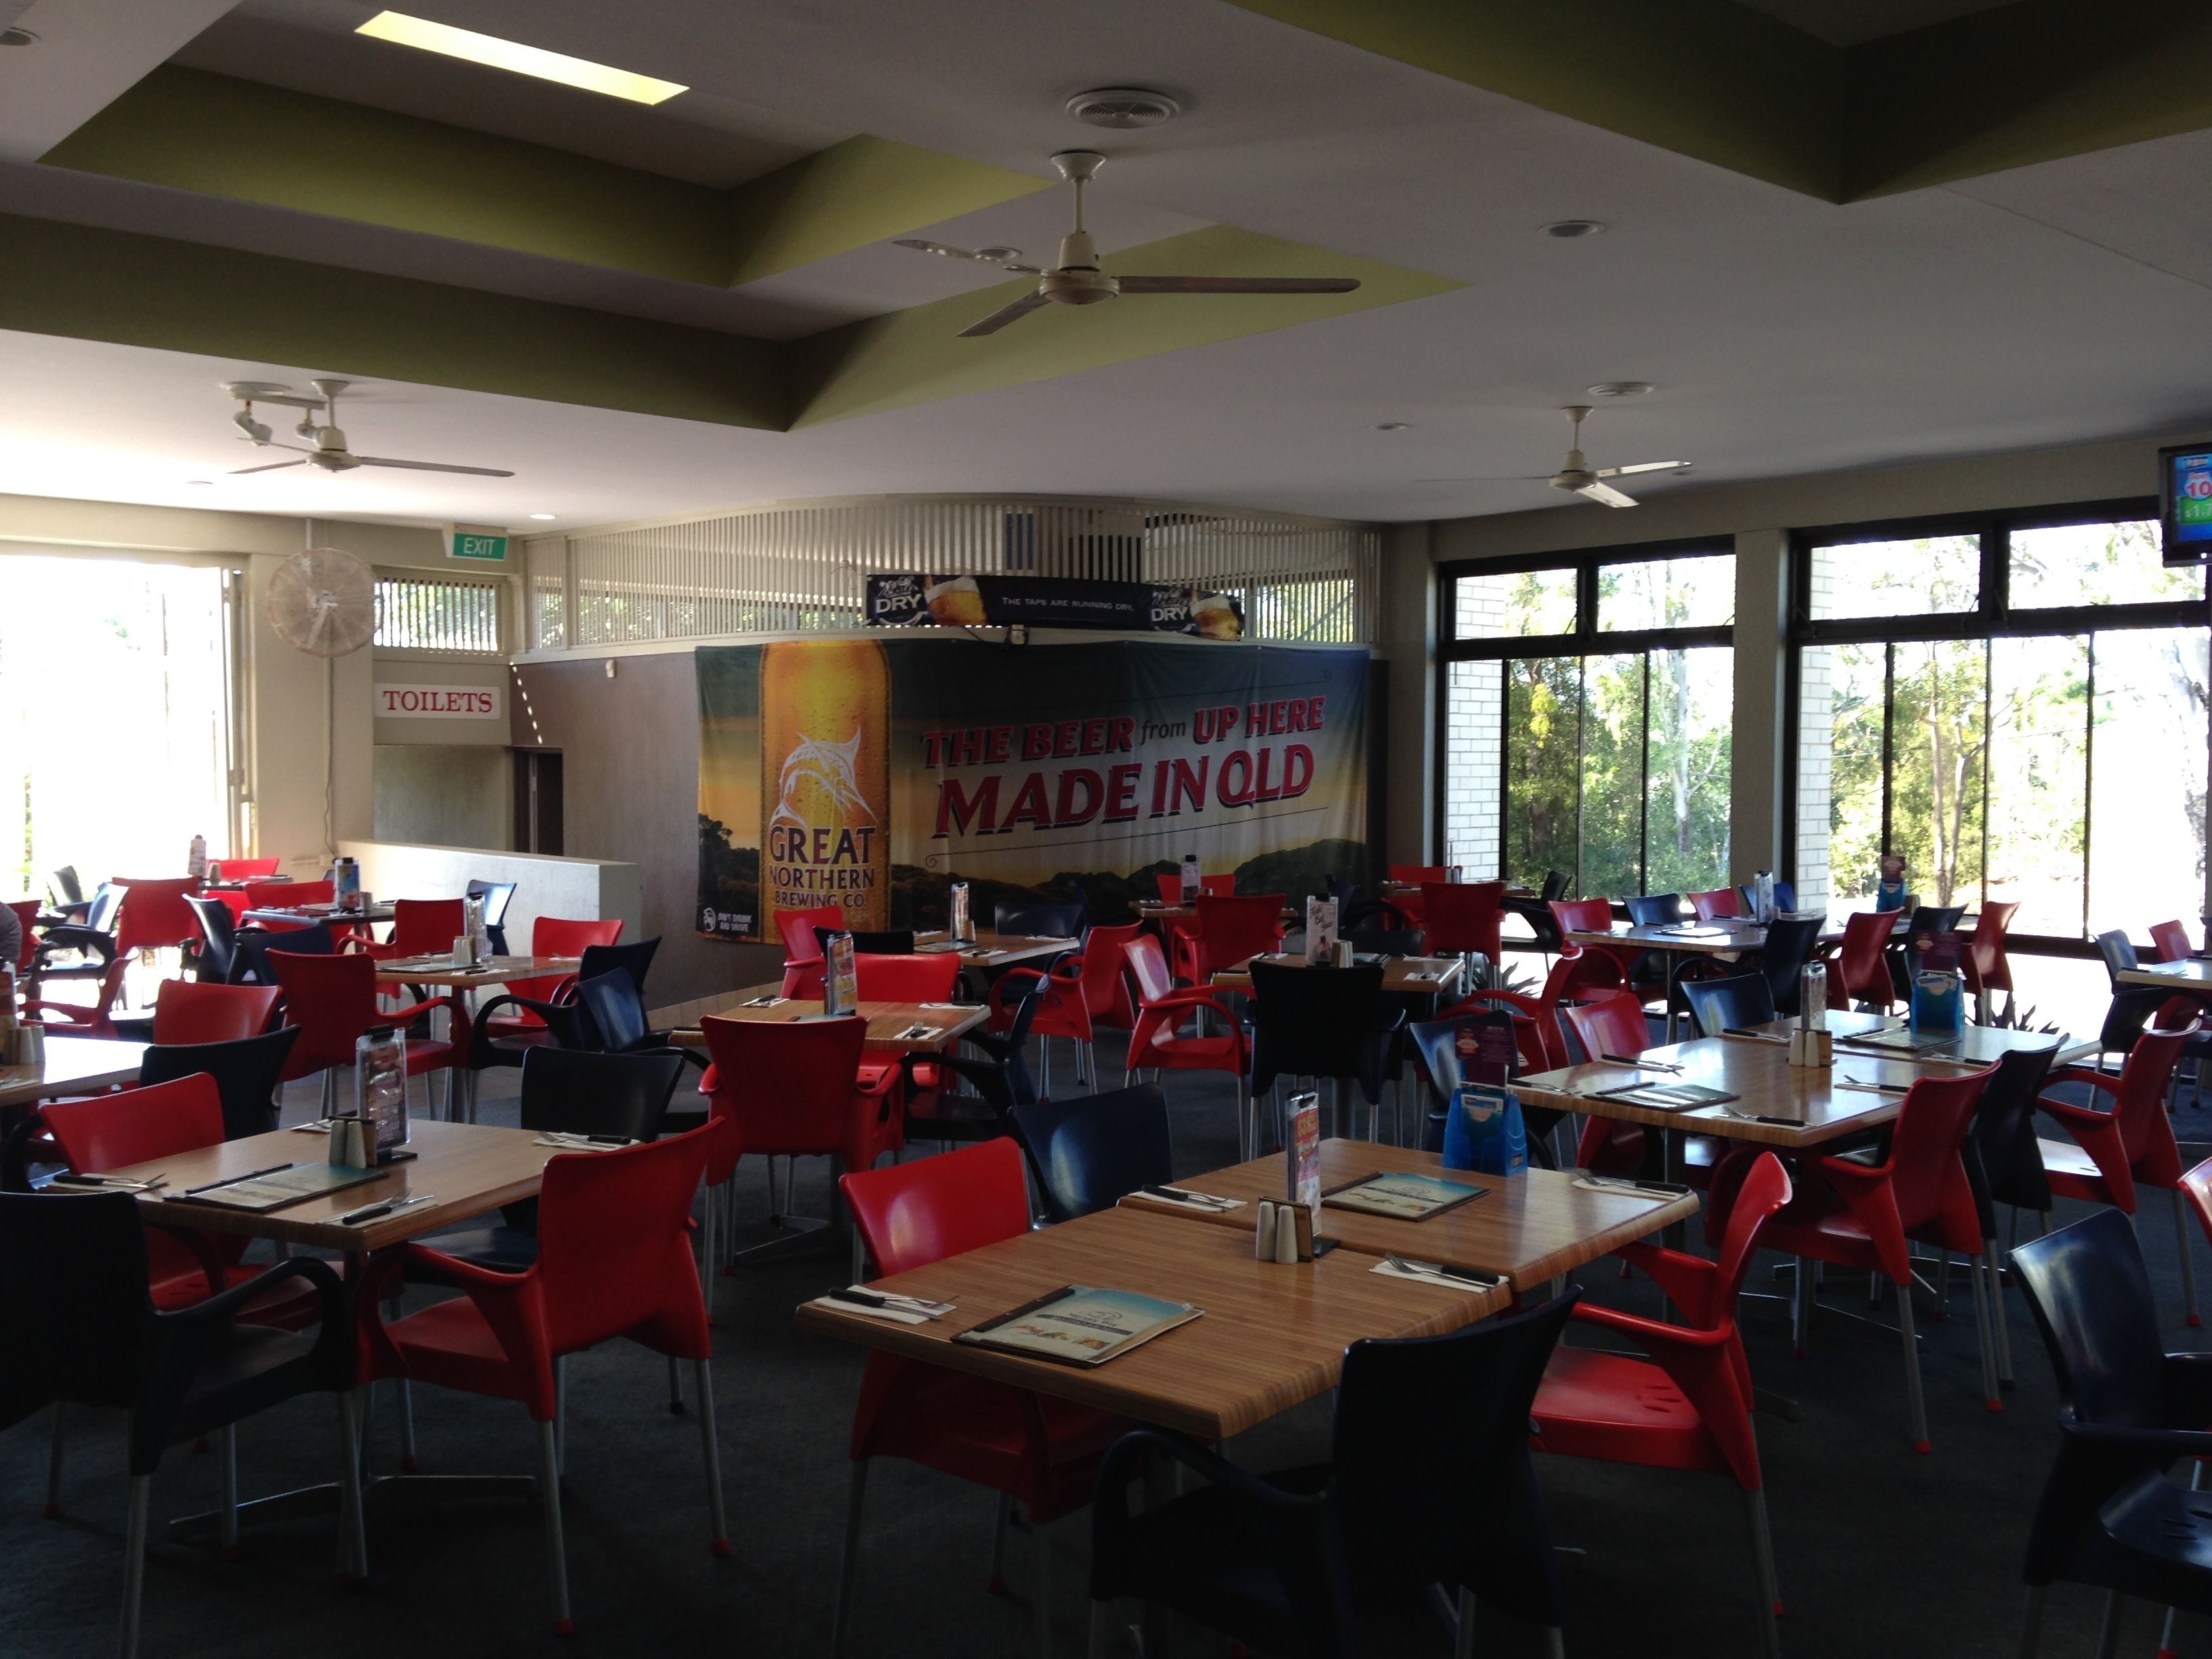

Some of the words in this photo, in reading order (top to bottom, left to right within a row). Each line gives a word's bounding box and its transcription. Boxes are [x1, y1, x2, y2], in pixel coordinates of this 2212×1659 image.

[464, 537, 495, 554] EXIT
[875, 593, 922, 613] DRY
[1002, 597, 1021, 605] THE
[1071, 600, 1113, 609] RUNNING
[1151, 607, 1188, 621] DRY
[384, 691, 493, 713] TOILETS
[924, 725, 1013, 769] THE
[1021, 716, 1136, 761] BEER
[1140, 719, 1187, 745] from
[1193, 705, 1240, 744] UP
[1245, 695, 1327, 738] HERE
[932, 762, 1143, 839] MADE
[1150, 755, 1210, 819] IN
[1216, 743, 1315, 811] QLD
[770, 825, 876, 865] GREAT
[769, 865, 875, 889] NORTHERN
[775, 890, 838, 908] BREWING
[843, 893, 867, 909] CO.
